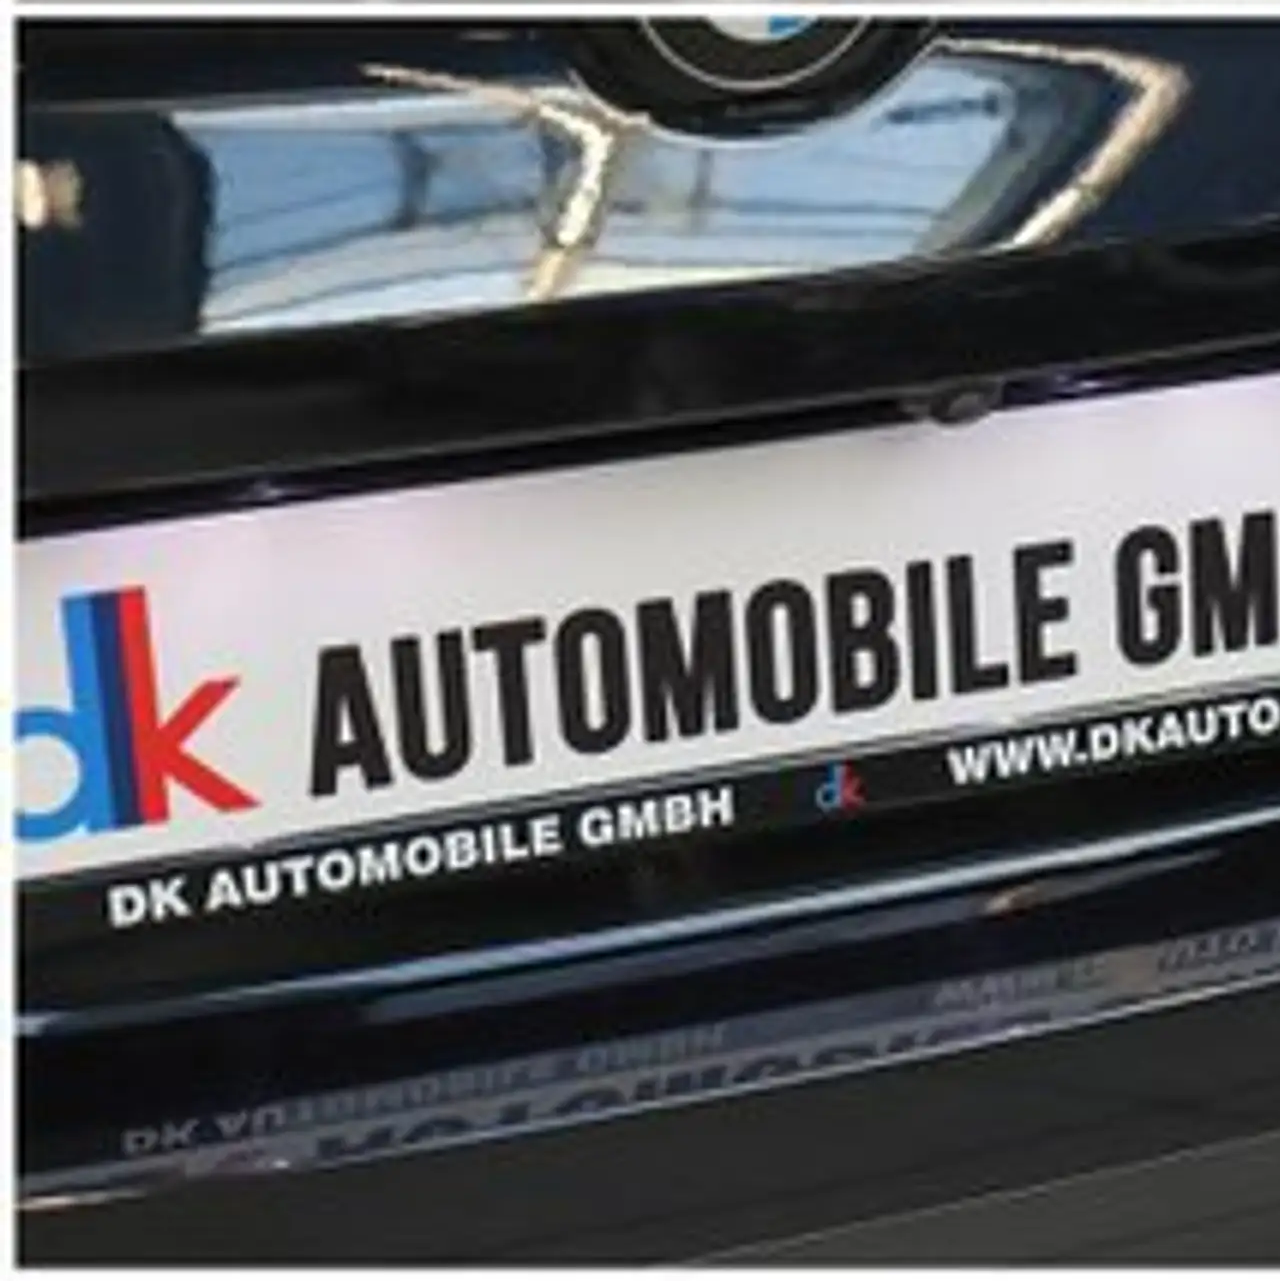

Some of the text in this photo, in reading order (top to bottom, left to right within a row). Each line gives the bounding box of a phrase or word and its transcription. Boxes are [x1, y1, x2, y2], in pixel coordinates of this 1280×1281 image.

[14, 585, 261, 845] dk
[311, 540, 1078, 798] AUTOMOBILE
[108, 883, 191, 929] DK
[205, 815, 562, 912] AUTOMOBILE
[578, 788, 736, 846] GMBH
